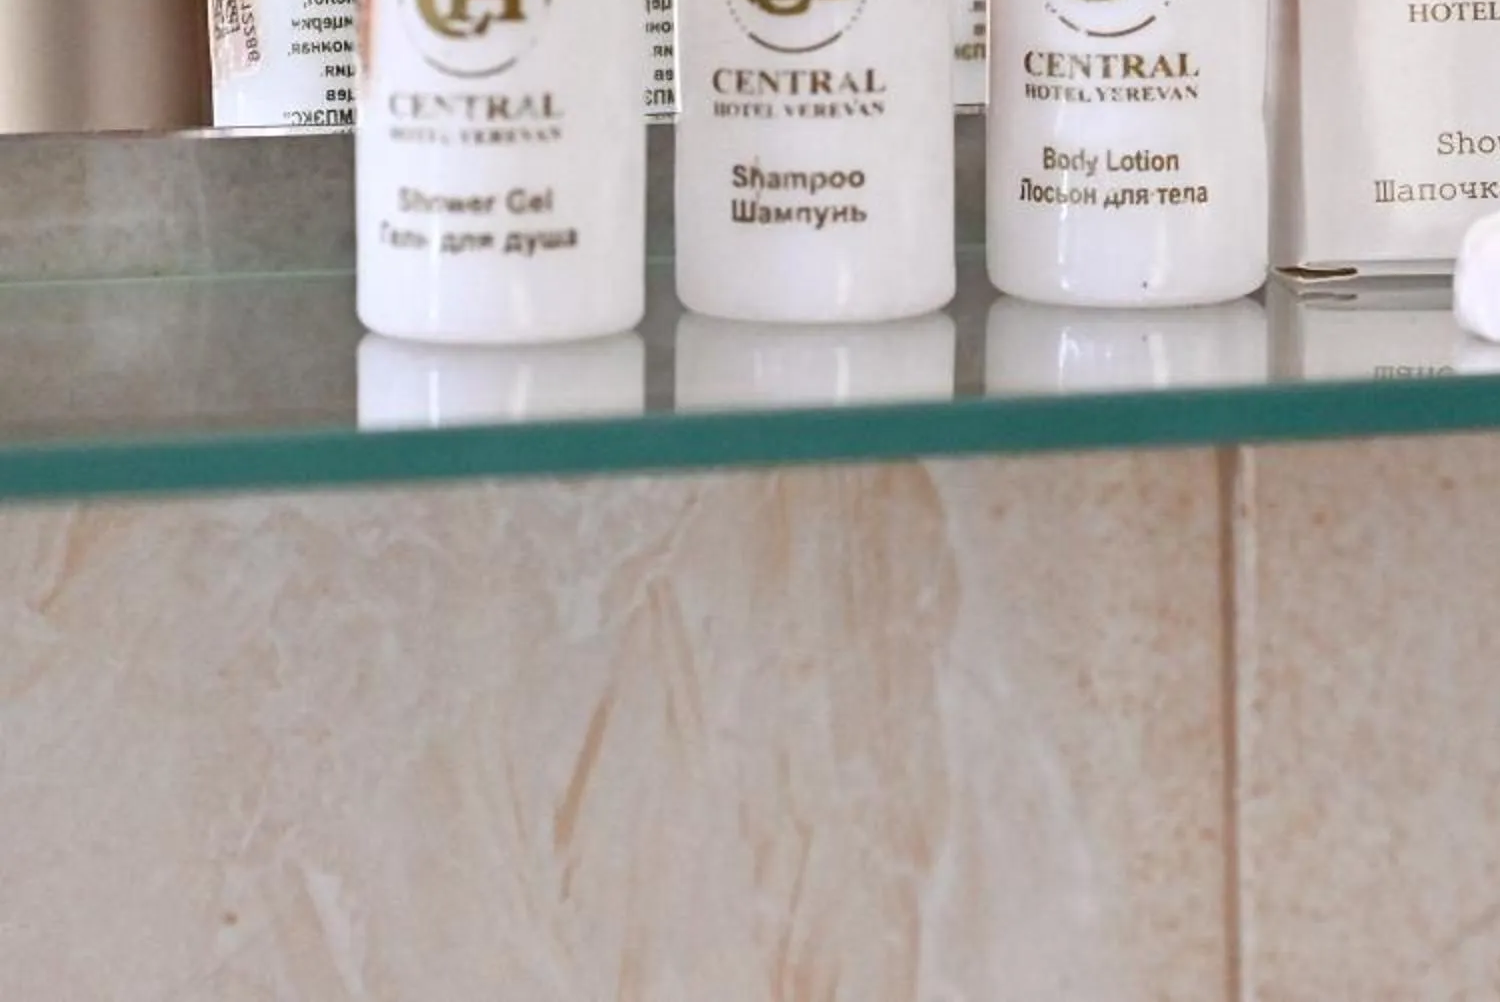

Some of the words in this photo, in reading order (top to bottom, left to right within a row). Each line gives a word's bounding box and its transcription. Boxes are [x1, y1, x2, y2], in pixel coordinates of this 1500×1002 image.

[1024, 51, 1199, 79] CENTRAL
[712, 68, 886, 95] CENTRAL
[1025, 83, 1091, 102] HOTEL
[1096, 85, 1198, 102] YEREVAN
[389, 92, 564, 121] CENTRAL
[713, 101, 773, 118] HOTEL
[784, 99, 885, 118] YEREVAN
[1043, 146, 1098, 176] Body
[1107, 150, 1179, 172] Lotion
[731, 162, 866, 194] Shampoo
[505, 188, 553, 213] Gel
[1020, 178, 1096, 205] Лосьон
[1103, 188, 1149, 209] для
[1156, 186, 1208, 205] тела
[731, 199, 867, 229] Шампунь
[502, 227, 578, 257] душа
